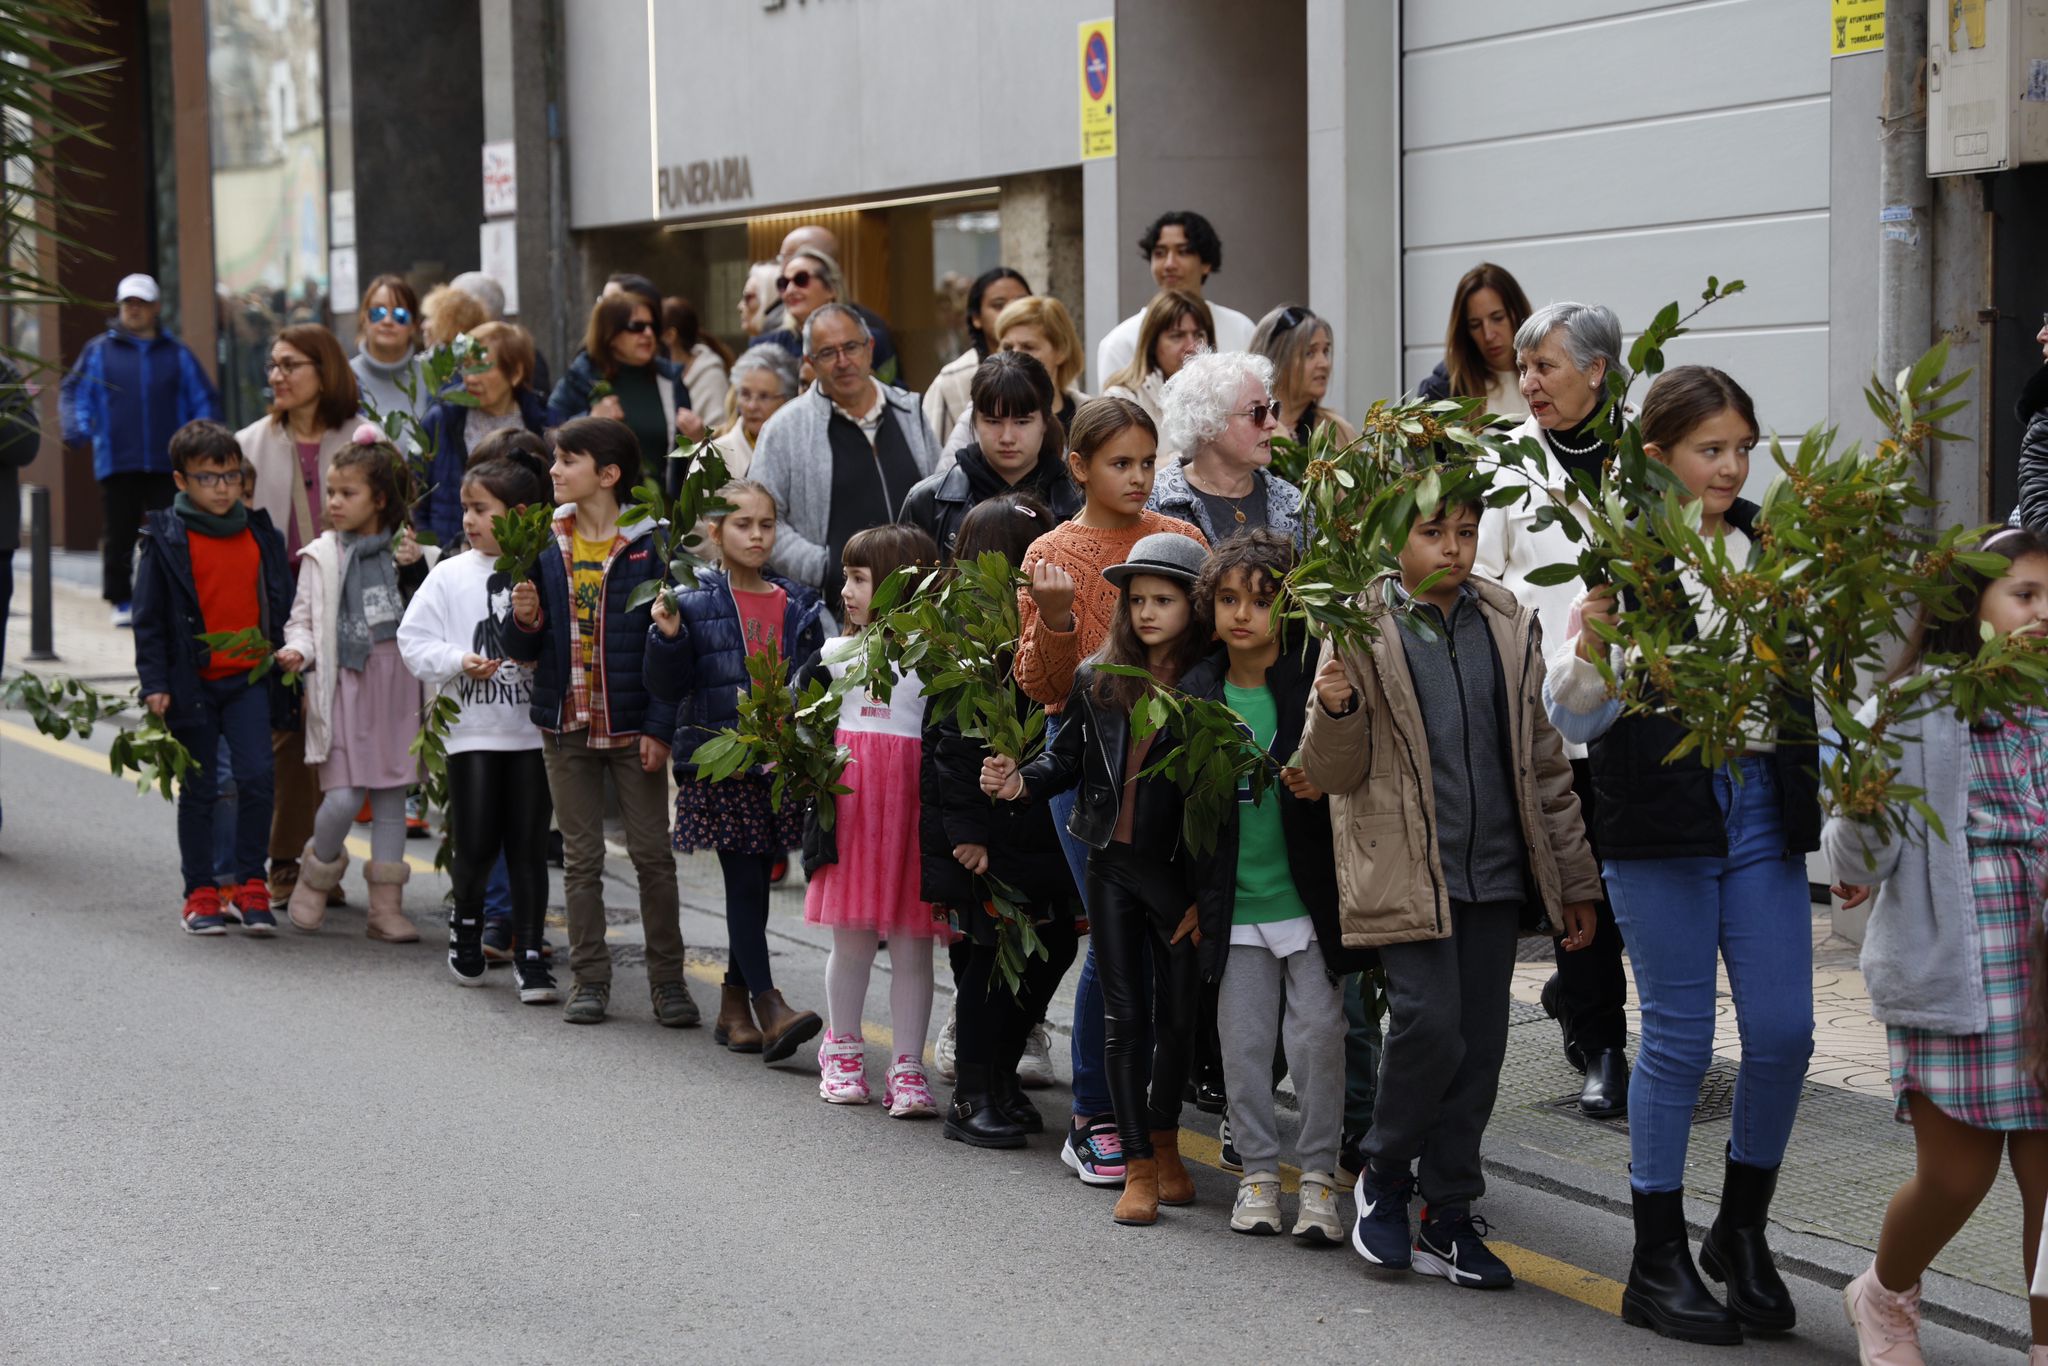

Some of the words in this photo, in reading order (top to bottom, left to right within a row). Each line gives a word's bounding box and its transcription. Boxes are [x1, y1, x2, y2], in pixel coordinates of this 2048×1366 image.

[1849, 12, 1885, 24] AYUNTAMIENT
[1864, 24, 1871, 32] DE
[658, 154, 753, 210] FUNERARIA
